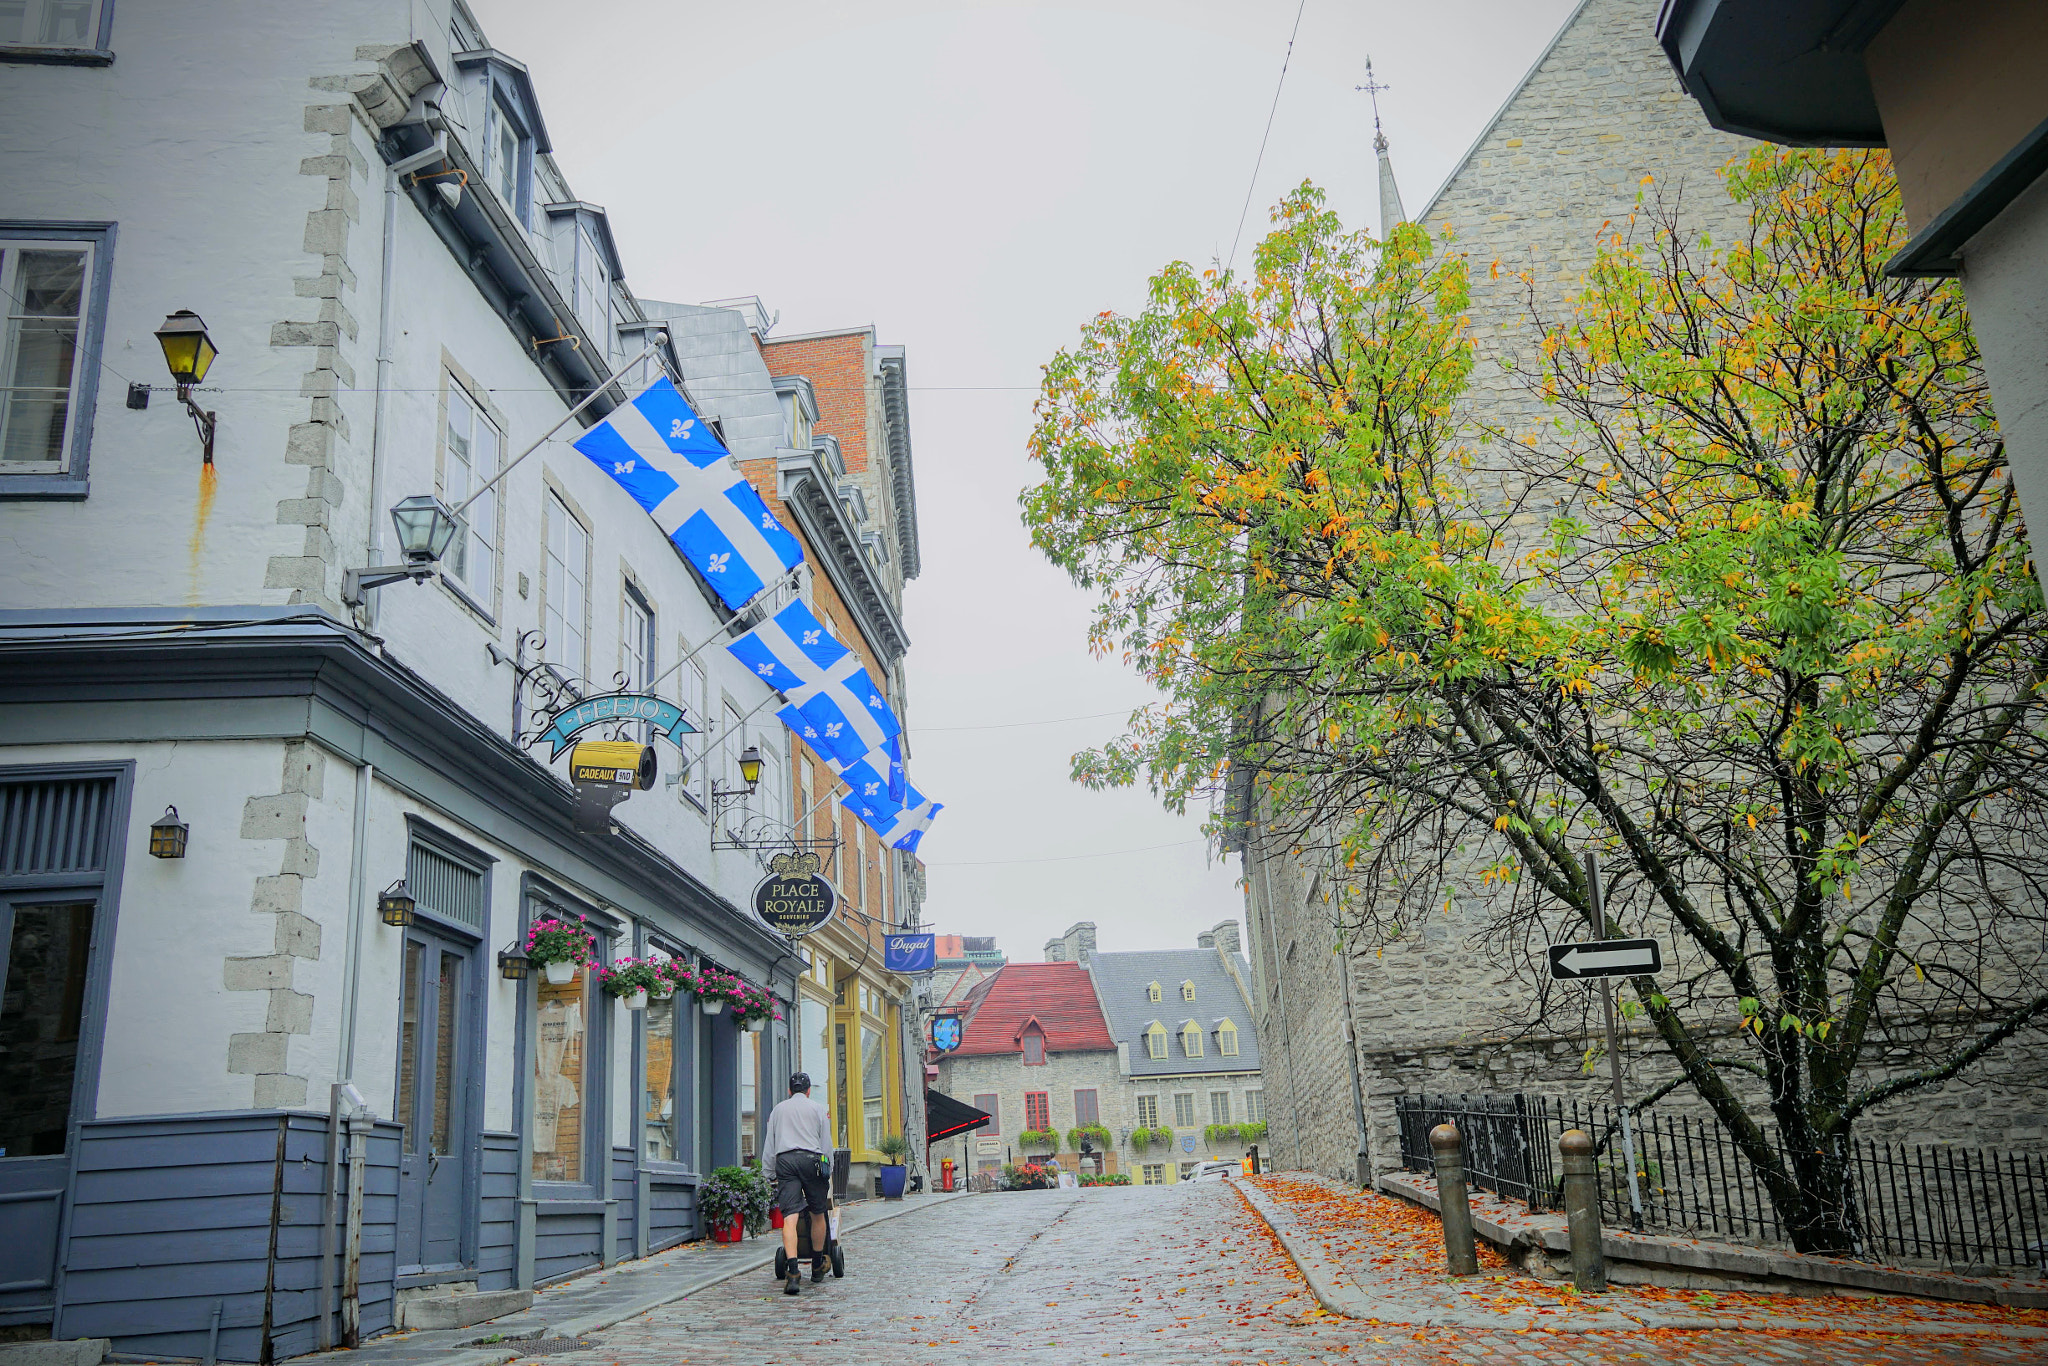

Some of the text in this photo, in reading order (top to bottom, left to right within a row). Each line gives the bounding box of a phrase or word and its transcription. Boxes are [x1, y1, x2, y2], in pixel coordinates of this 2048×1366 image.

[575, 697, 660, 725] FEEJO
[579, 768, 616, 781] CADEAUX
[772, 884, 819, 897] PLACE
[764, 900, 825, 913] ROYALE
[890, 937, 930, 953] Dugal
